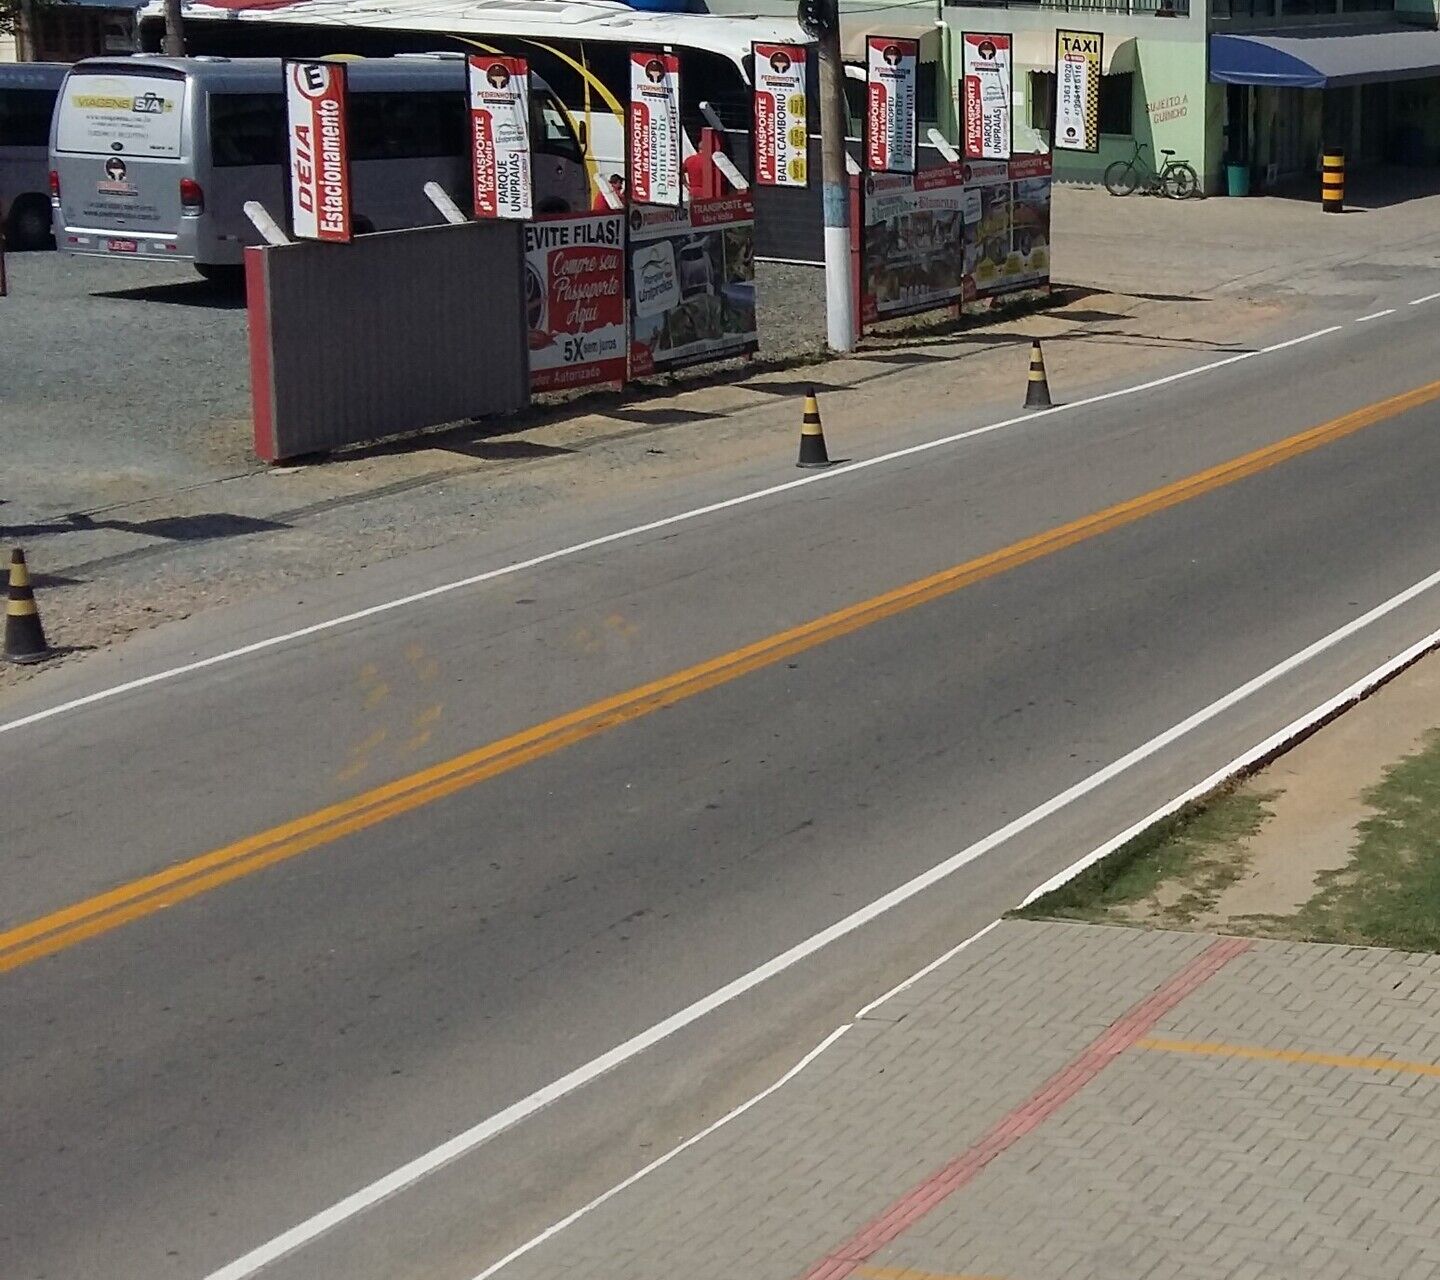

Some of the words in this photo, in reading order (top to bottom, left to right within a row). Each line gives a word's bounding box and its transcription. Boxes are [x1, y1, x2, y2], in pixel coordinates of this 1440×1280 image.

[135, 98, 163, 112] S/A
[758, 97, 767, 170] TRANSPORTE
[774, 94, 786, 150] CAMBORIÚ
[870, 88, 879, 155] TRANSPORTE
[967, 81, 976, 144] TRANSPORTE
[984, 114, 992, 148] PARQUE
[993, 108, 1002, 153] UNIPRAIAS
[294, 125, 313, 213] DÉIA
[319, 100, 344, 232] Estacionamento
[475, 117, 486, 200] TRANSPORTE
[486, 140, 495, 166] Volta
[634, 109, 642, 186] TRANSPORTE
[486, 176, 495, 191] Ida
[497, 160, 509, 204] PARQUE
[509, 153, 521, 212] UNIPRAIAS
[525, 226, 569, 252] EVITE
[573, 219, 620, 245] FILAS!
